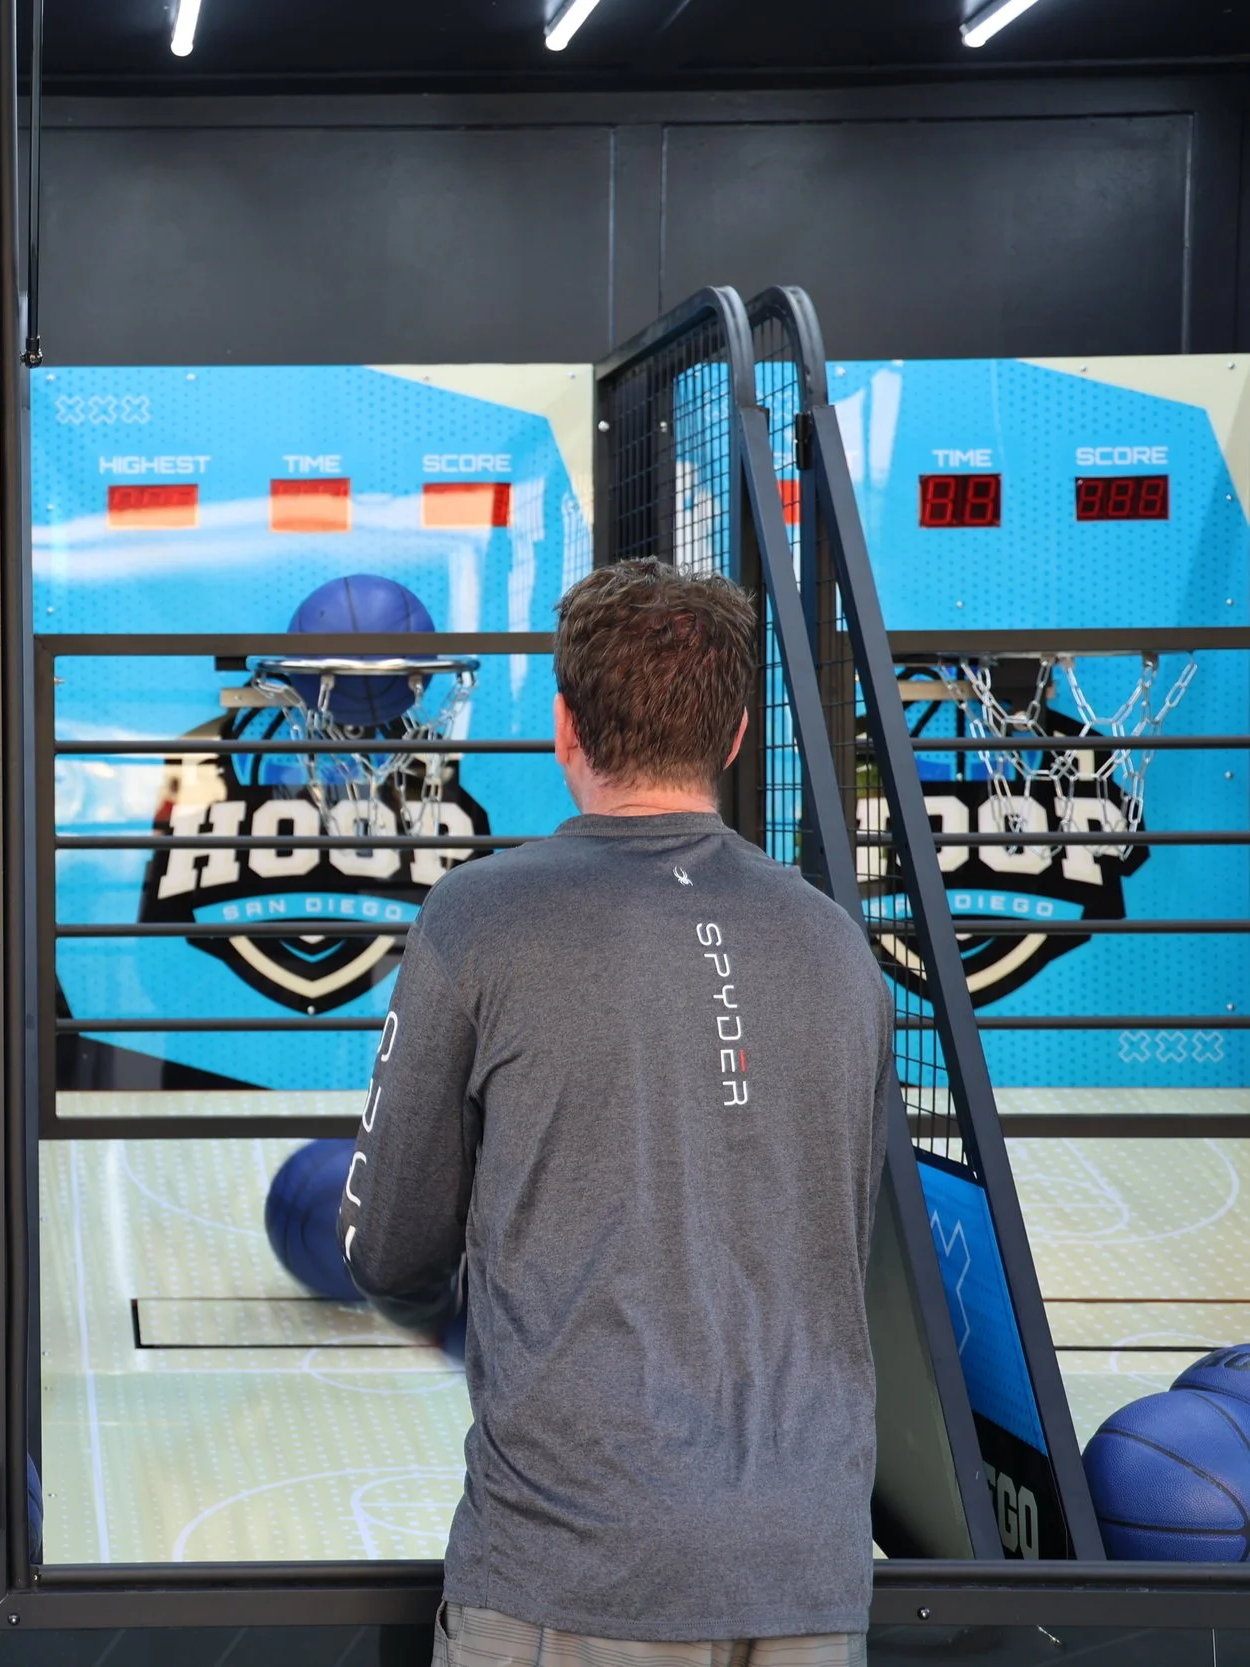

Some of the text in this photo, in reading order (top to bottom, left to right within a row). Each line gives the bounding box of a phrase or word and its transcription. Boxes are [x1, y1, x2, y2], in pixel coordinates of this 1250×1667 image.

[99, 456, 210, 474] HIGHEST
[283, 455, 341, 472] TIME
[422, 454, 512, 472] SCORE
[932, 449, 992, 467] TIME
[1076, 447, 1168, 465] SCORE
[157, 799, 474, 899] HOOP
[223, 898, 401, 920] SAN DIEGO
[954, 894, 1054, 917] DIEGO
[696, 922, 748, 1106] SPYDER
